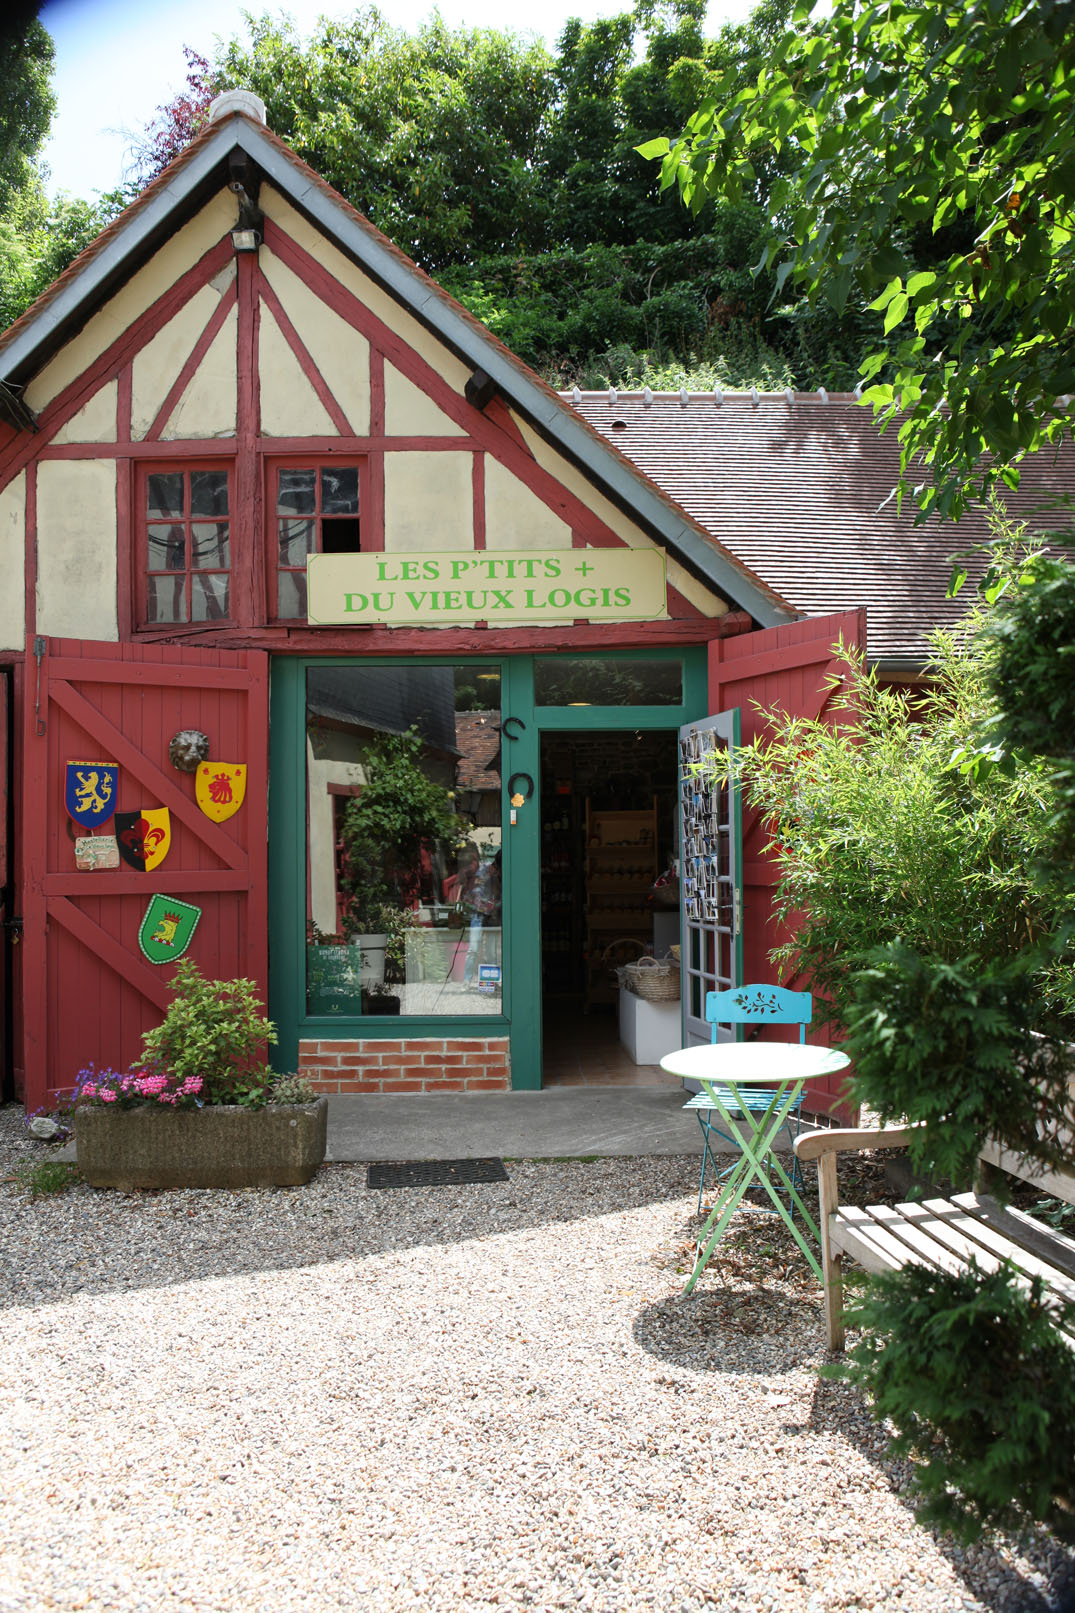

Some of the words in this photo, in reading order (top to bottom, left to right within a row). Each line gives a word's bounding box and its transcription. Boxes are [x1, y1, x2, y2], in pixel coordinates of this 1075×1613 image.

[376, 561, 440, 581] LES
[450, 559, 561, 580] P'TITS
[343, 592, 395, 613] DU
[405, 590, 514, 611] VIEUX
[525, 588, 632, 609] LOGIS
